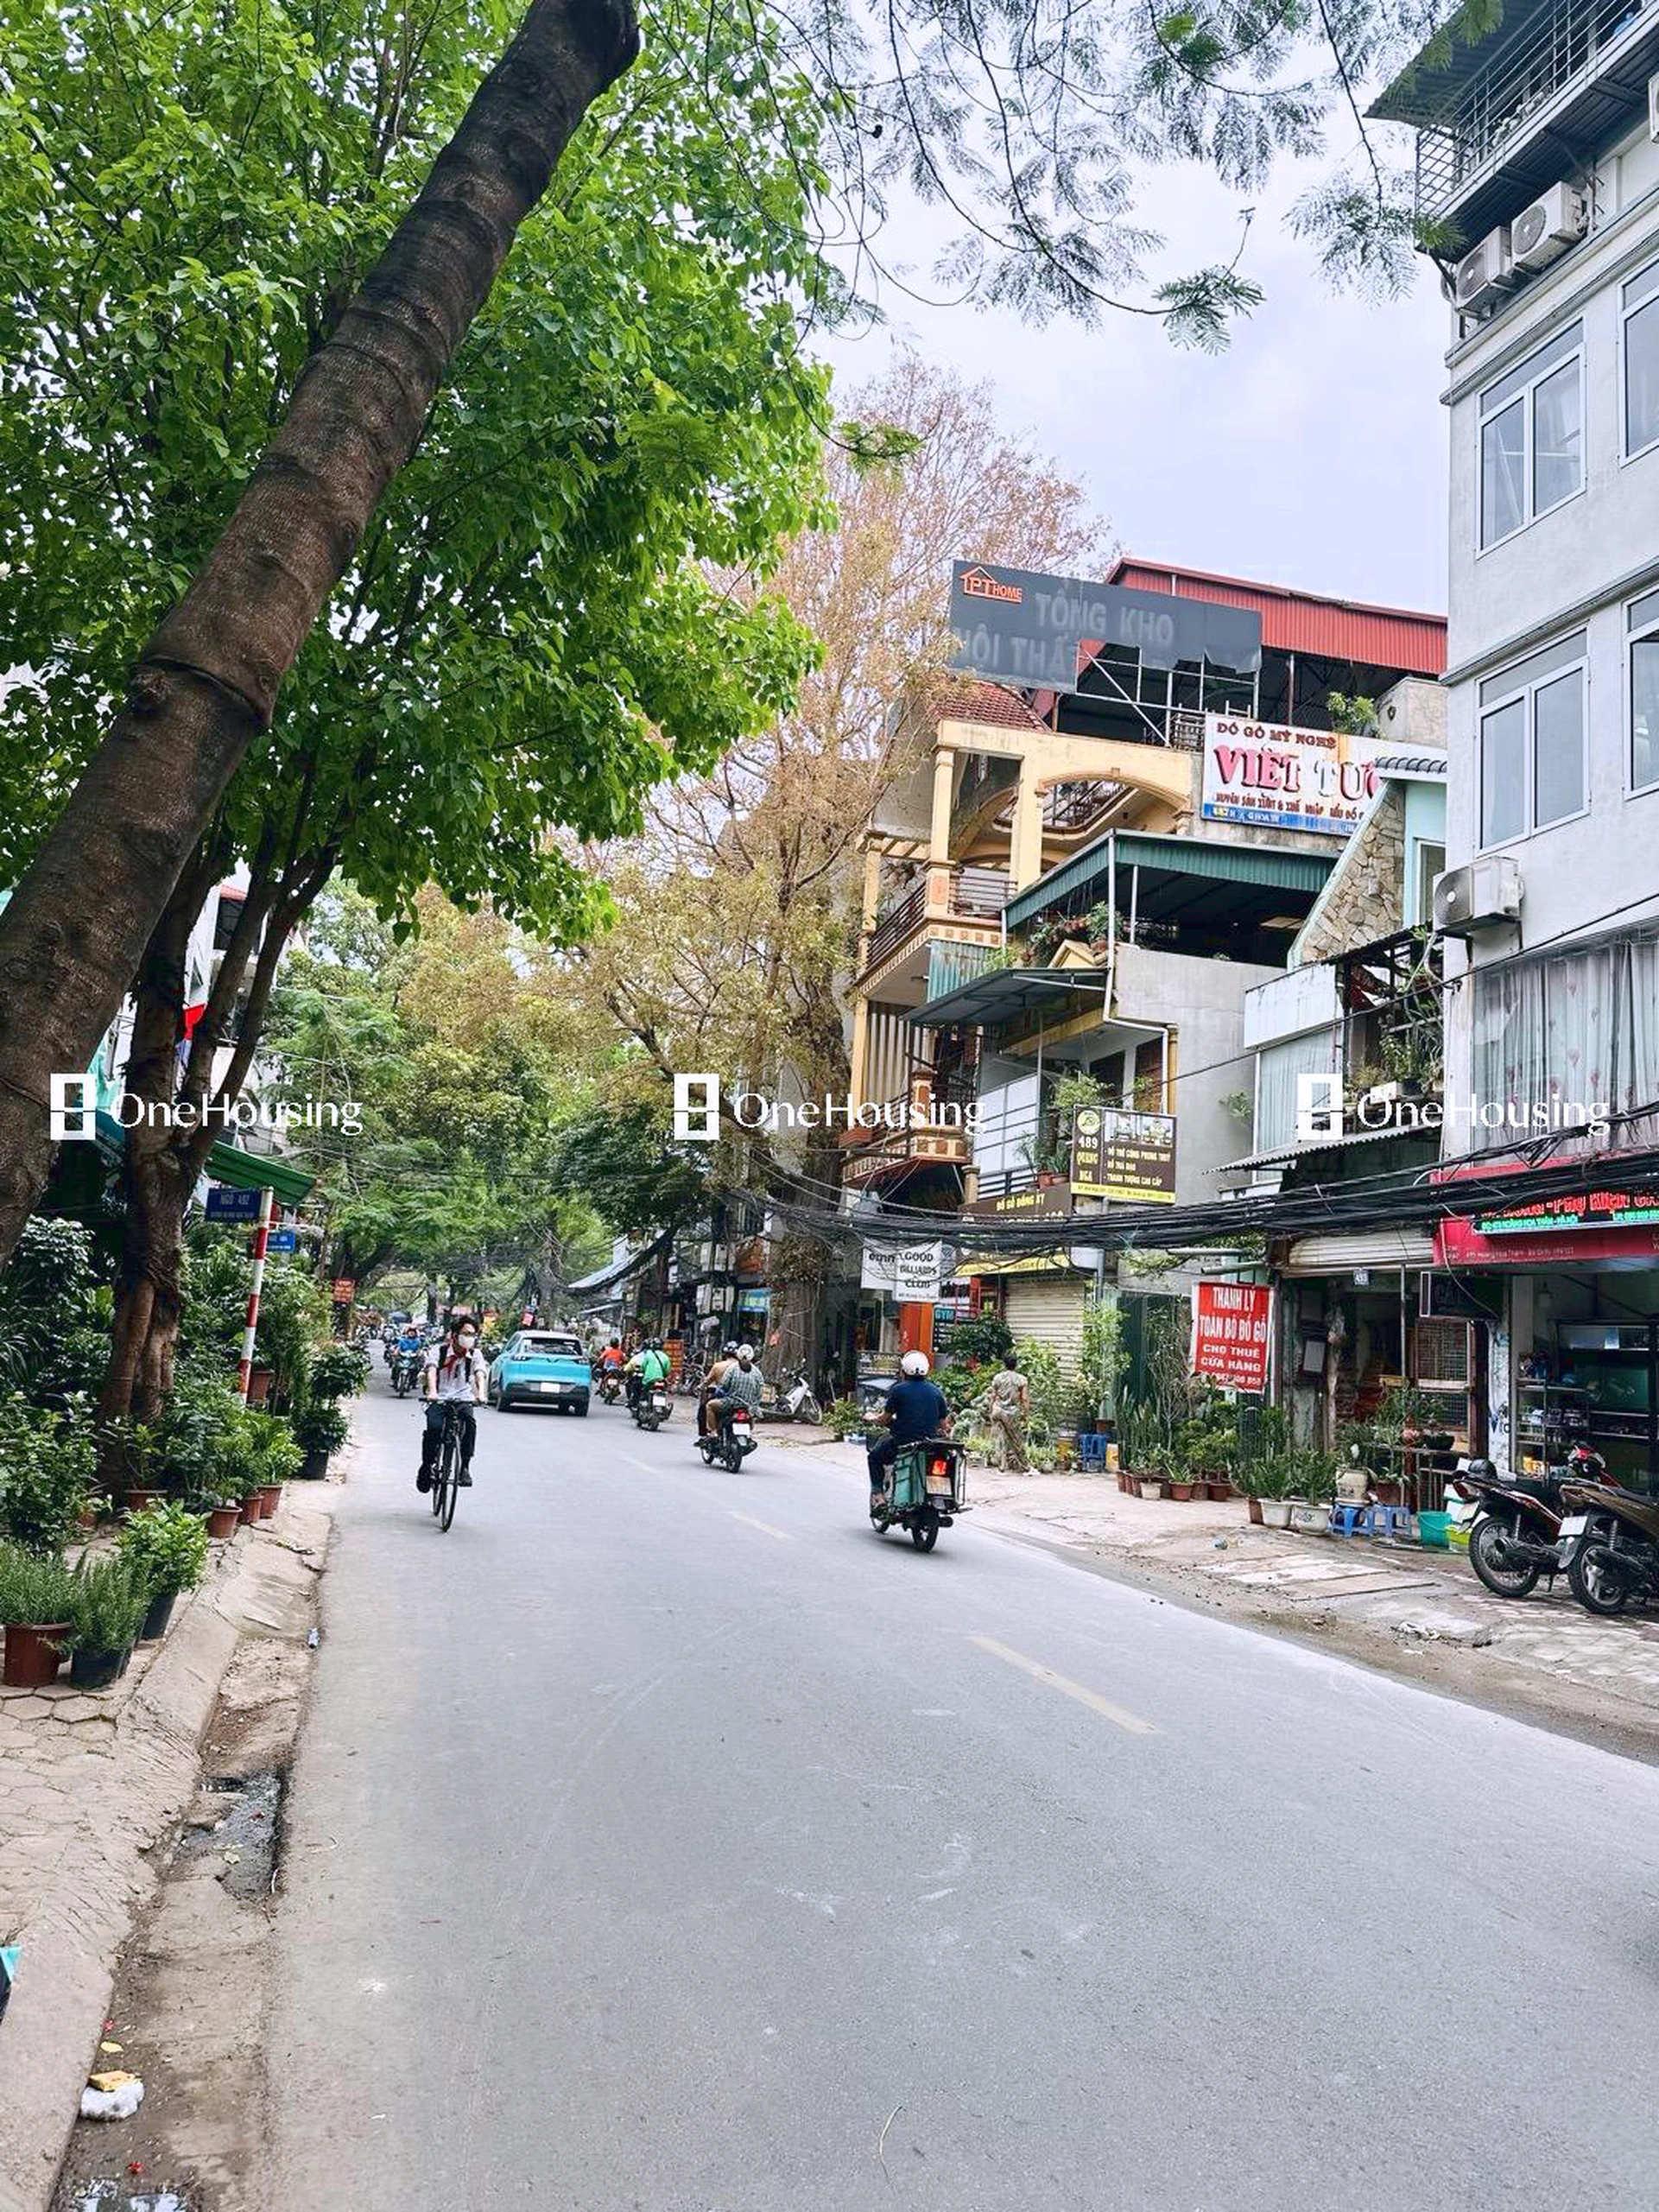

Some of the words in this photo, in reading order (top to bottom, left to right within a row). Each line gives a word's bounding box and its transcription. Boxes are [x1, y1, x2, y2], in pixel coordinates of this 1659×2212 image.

[992, 584, 1023, 601] HOME
[1120, 606, 1174, 645] KHO
[1078, 1136, 1099, 1149] 489
[904, 1252, 934, 1262] GOOD
[1213, 1287, 1244, 1310] THANH
[1244, 1286, 1256, 1312] LÝ
[934, 1309, 954, 1320] GYM
[1203, 1344, 1227, 1354] CHO
[1231, 1345, 1260, 1359] THUÊ
[1200, 1355, 1225, 1368] CỬA
[1228, 1360, 1261, 1372] HÀNG
